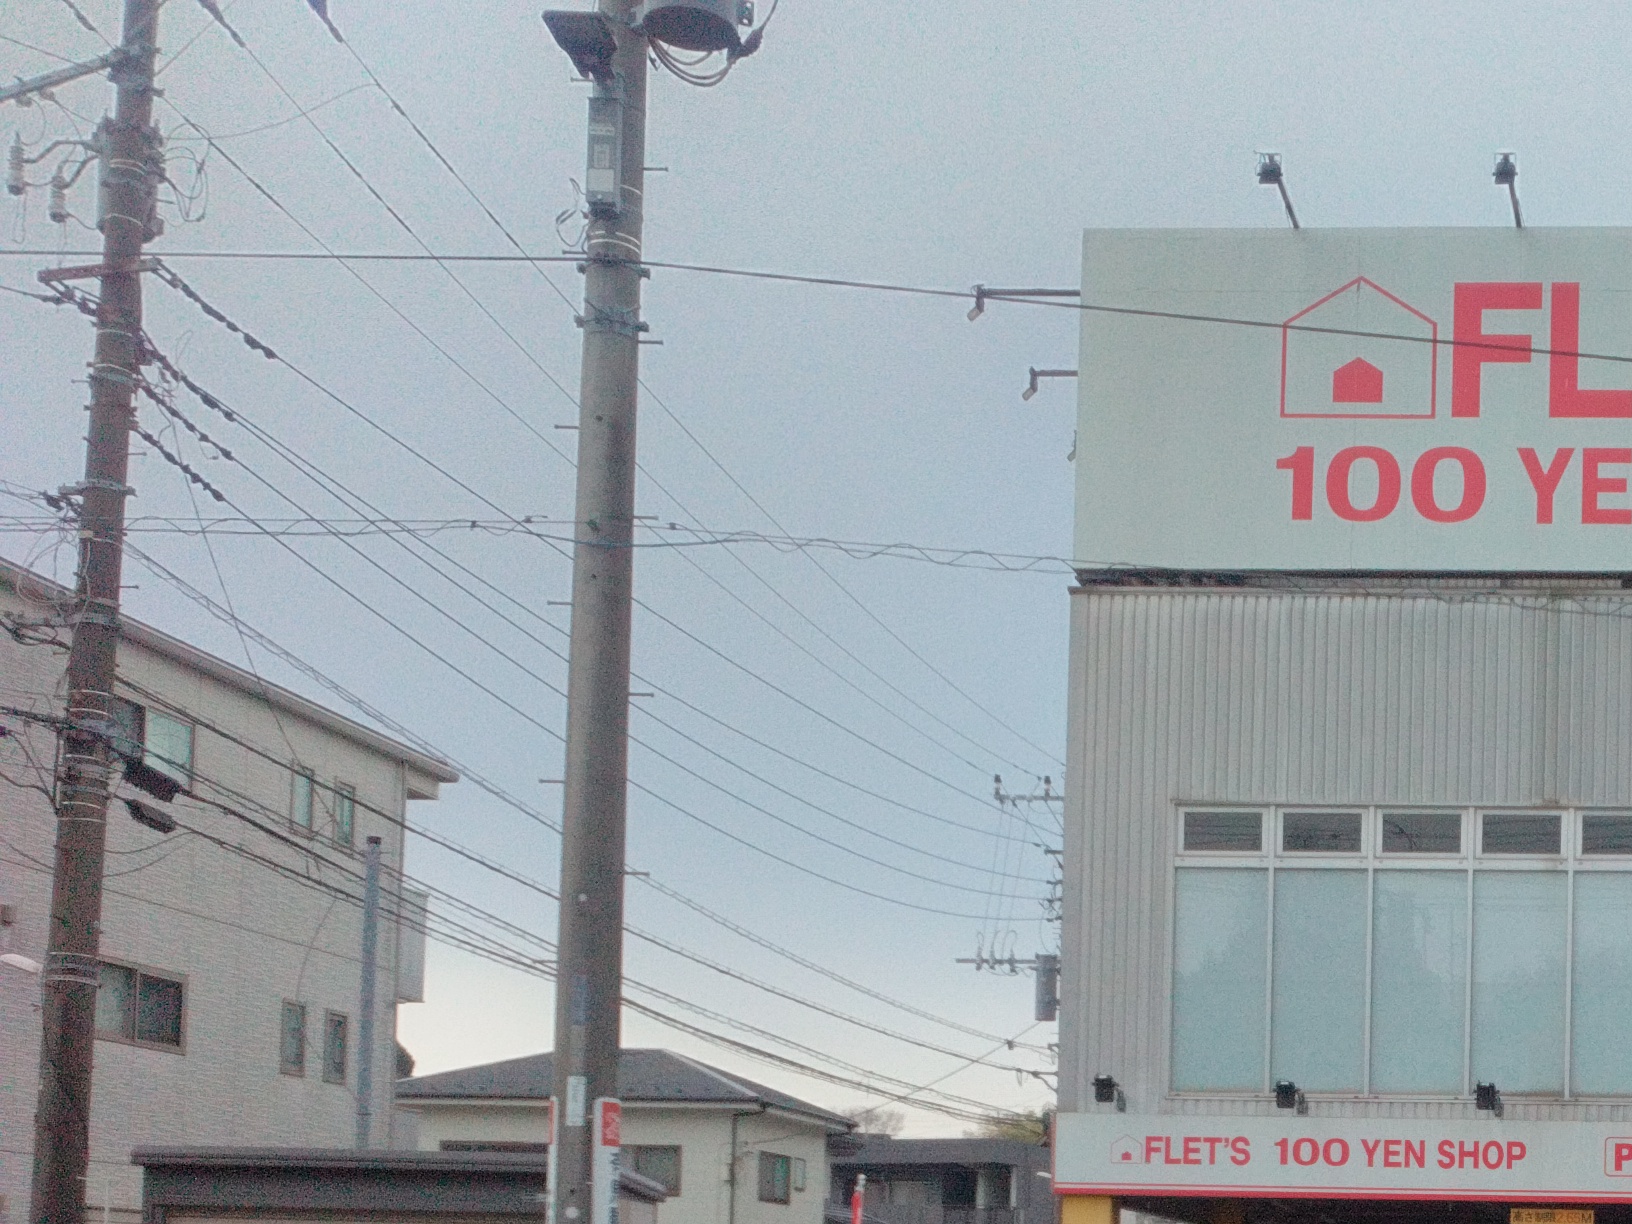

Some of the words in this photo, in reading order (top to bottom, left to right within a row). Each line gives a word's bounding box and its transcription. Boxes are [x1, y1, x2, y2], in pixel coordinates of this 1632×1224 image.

[1275, 446, 1488, 524] 100
[1144, 1135, 1251, 1166] FLET'S
[1274, 1137, 1351, 1167] 100
[1361, 1139, 1427, 1168] YEN
[1437, 1139, 1528, 1170] SHOP
